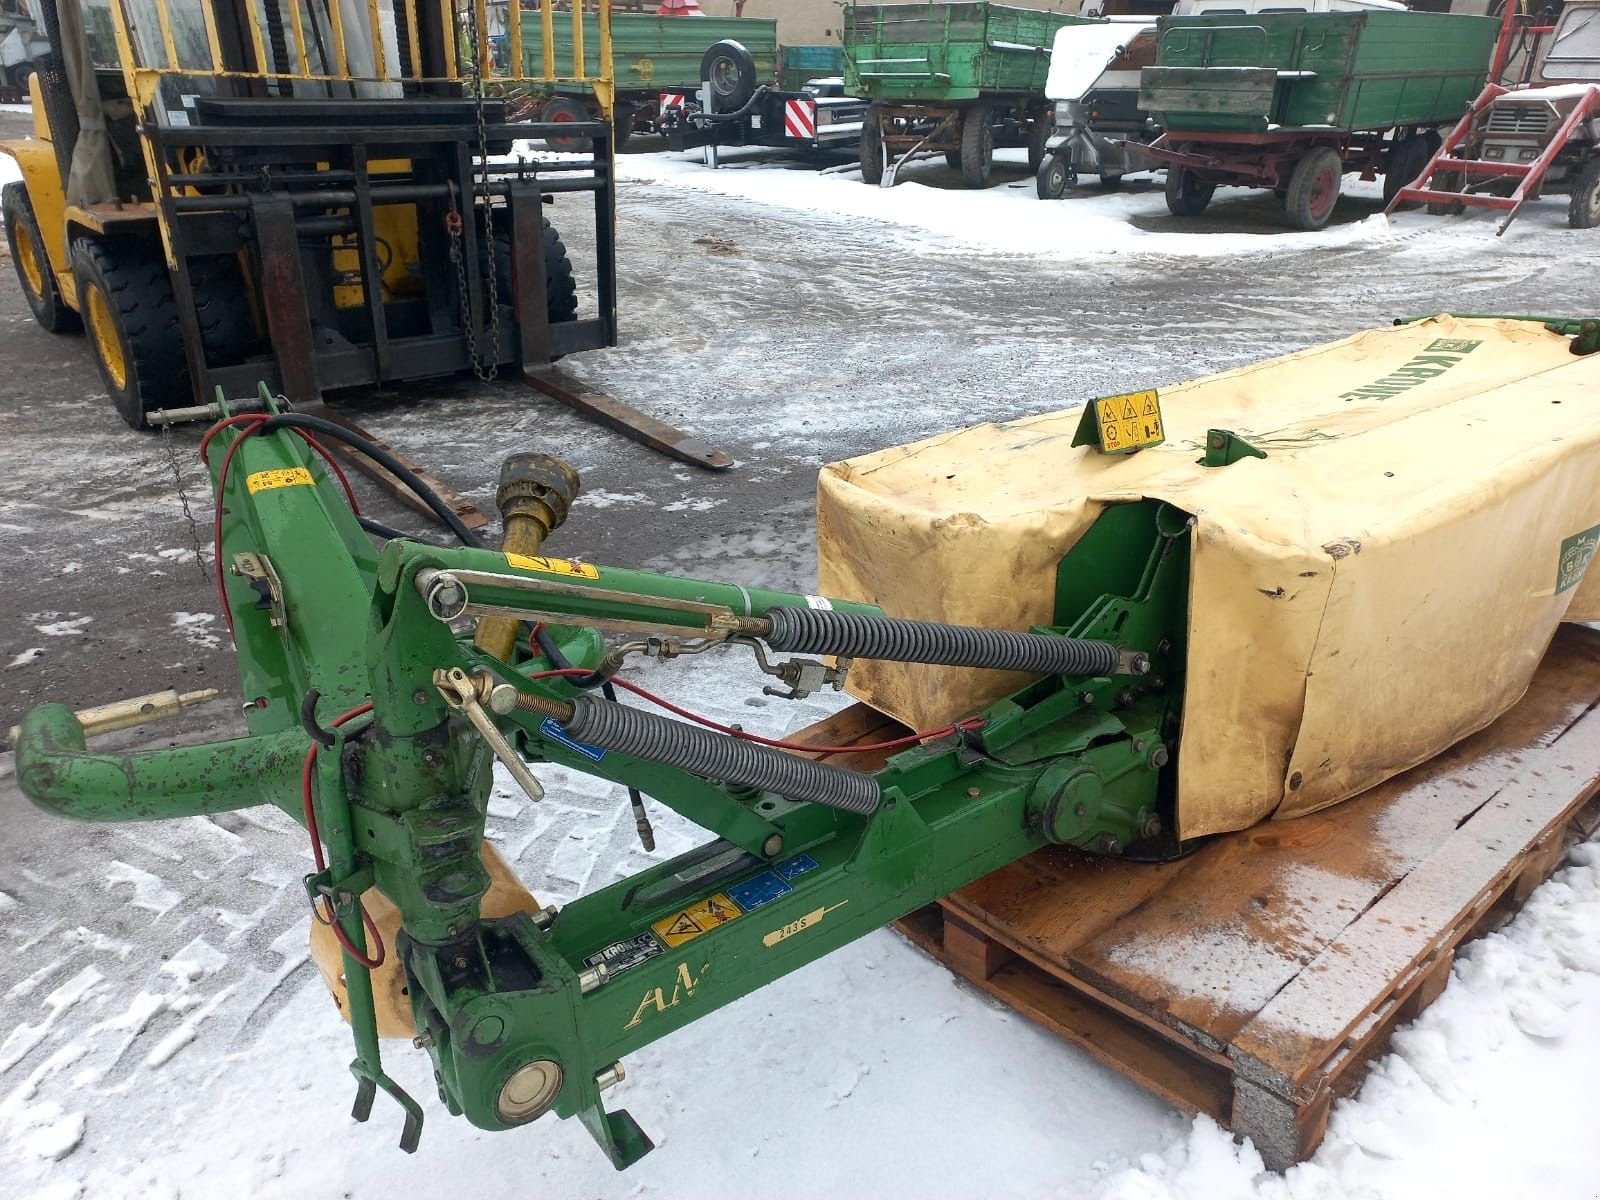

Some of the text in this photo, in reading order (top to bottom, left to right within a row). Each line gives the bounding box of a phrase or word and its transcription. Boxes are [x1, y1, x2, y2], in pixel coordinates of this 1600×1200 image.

[1338, 355, 1463, 401] KRONE
[1107, 440, 1120, 449] STOP
[602, 939, 640, 960] KRONE
